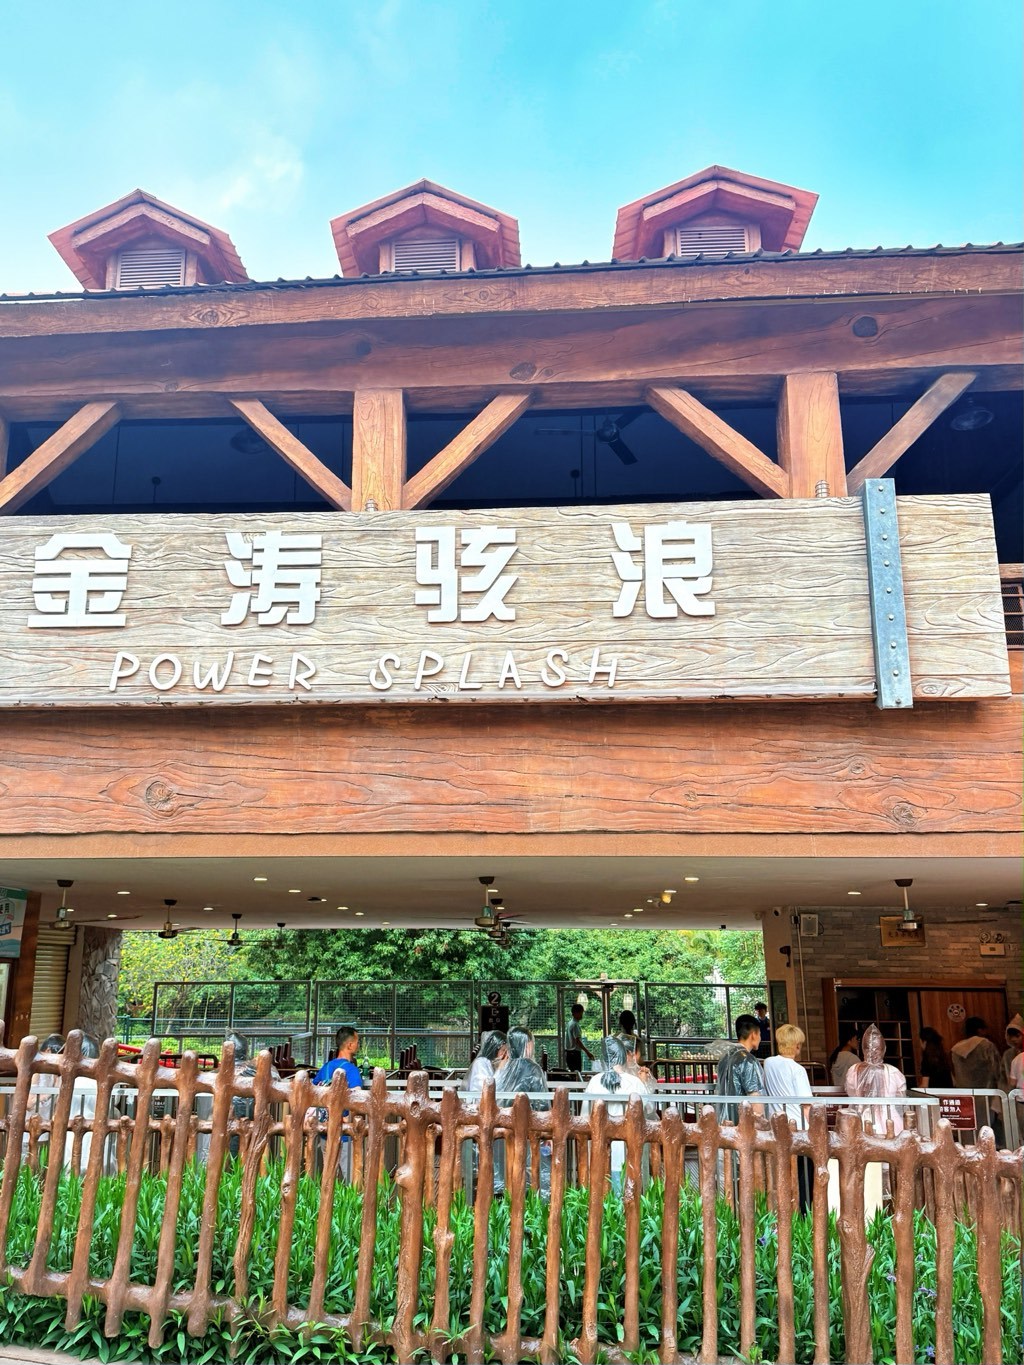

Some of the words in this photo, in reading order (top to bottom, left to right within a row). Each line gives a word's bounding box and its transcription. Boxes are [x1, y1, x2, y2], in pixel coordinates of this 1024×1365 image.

[27, 521, 716, 628] 金涛骇浪
[109, 650, 317, 692] POWER
[369, 649, 619, 690] SPLASH
[491, 992, 499, 1004] 2
